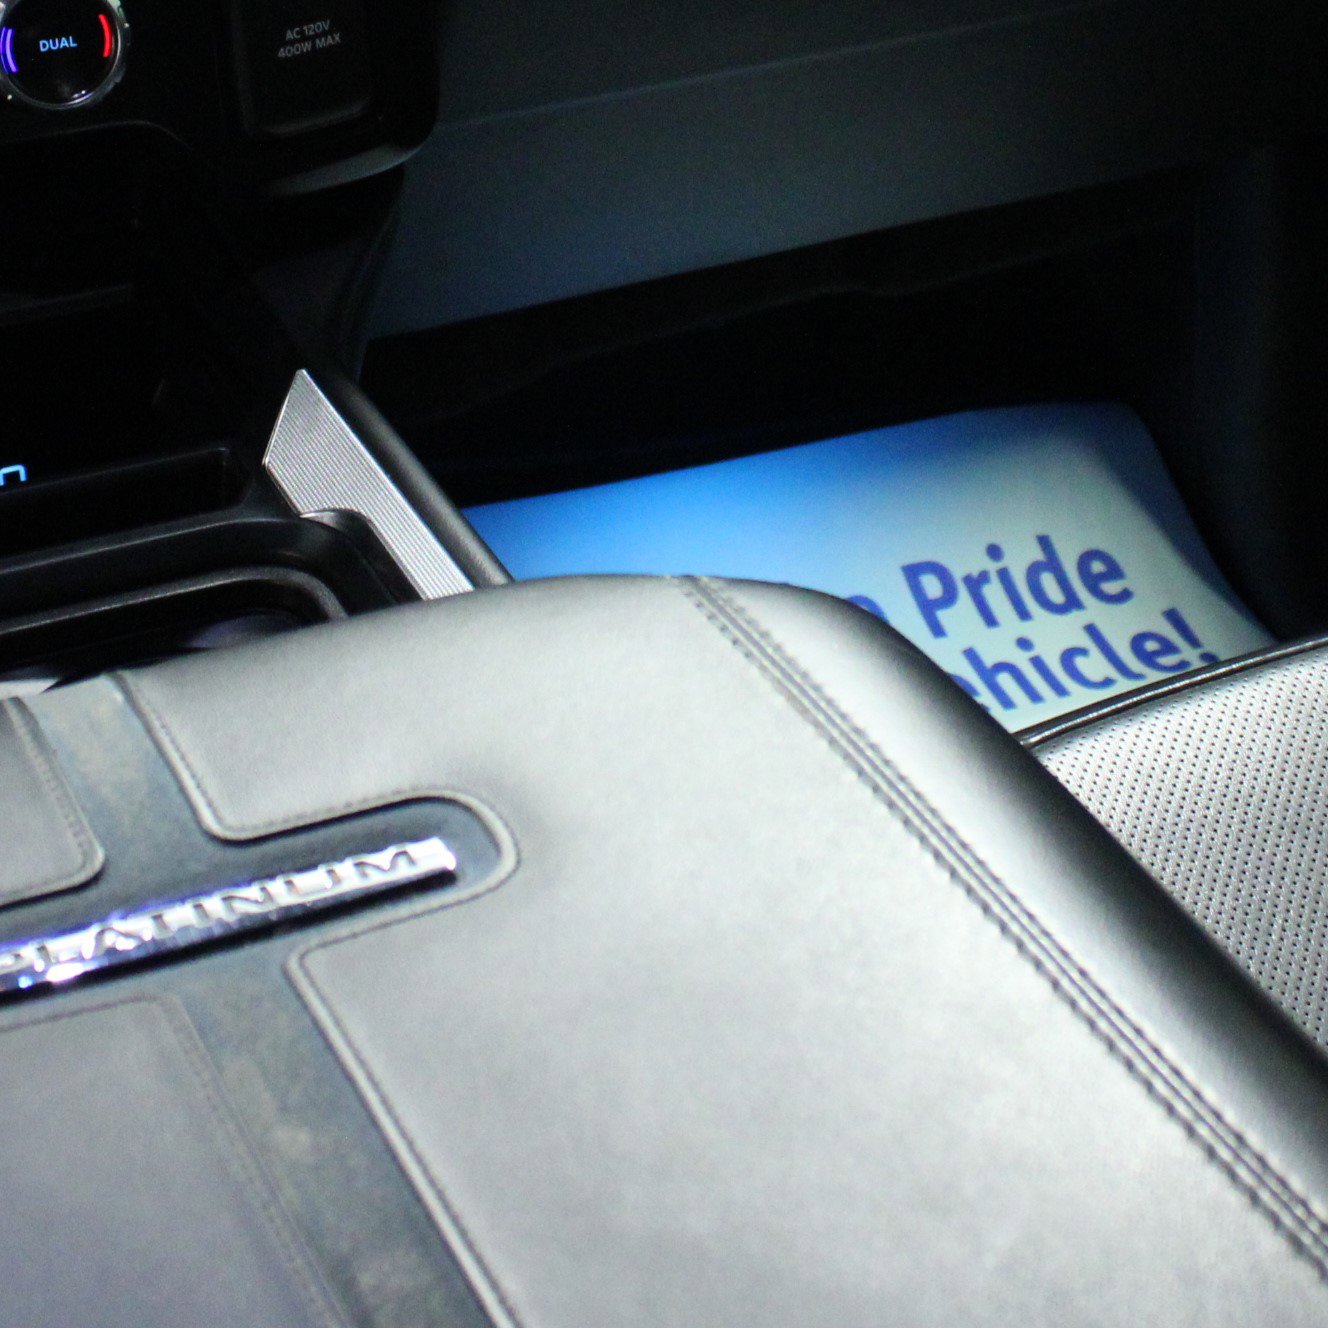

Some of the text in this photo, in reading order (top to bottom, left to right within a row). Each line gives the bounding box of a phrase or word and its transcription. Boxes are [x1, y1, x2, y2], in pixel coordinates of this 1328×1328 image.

[38, 35, 77, 51] DUAL
[286, 20, 330, 41] AC 120V
[278, 32, 341, 59] 400W MAX
[902, 535, 1134, 639] Pride
[948, 608, 1220, 711] hicle!
